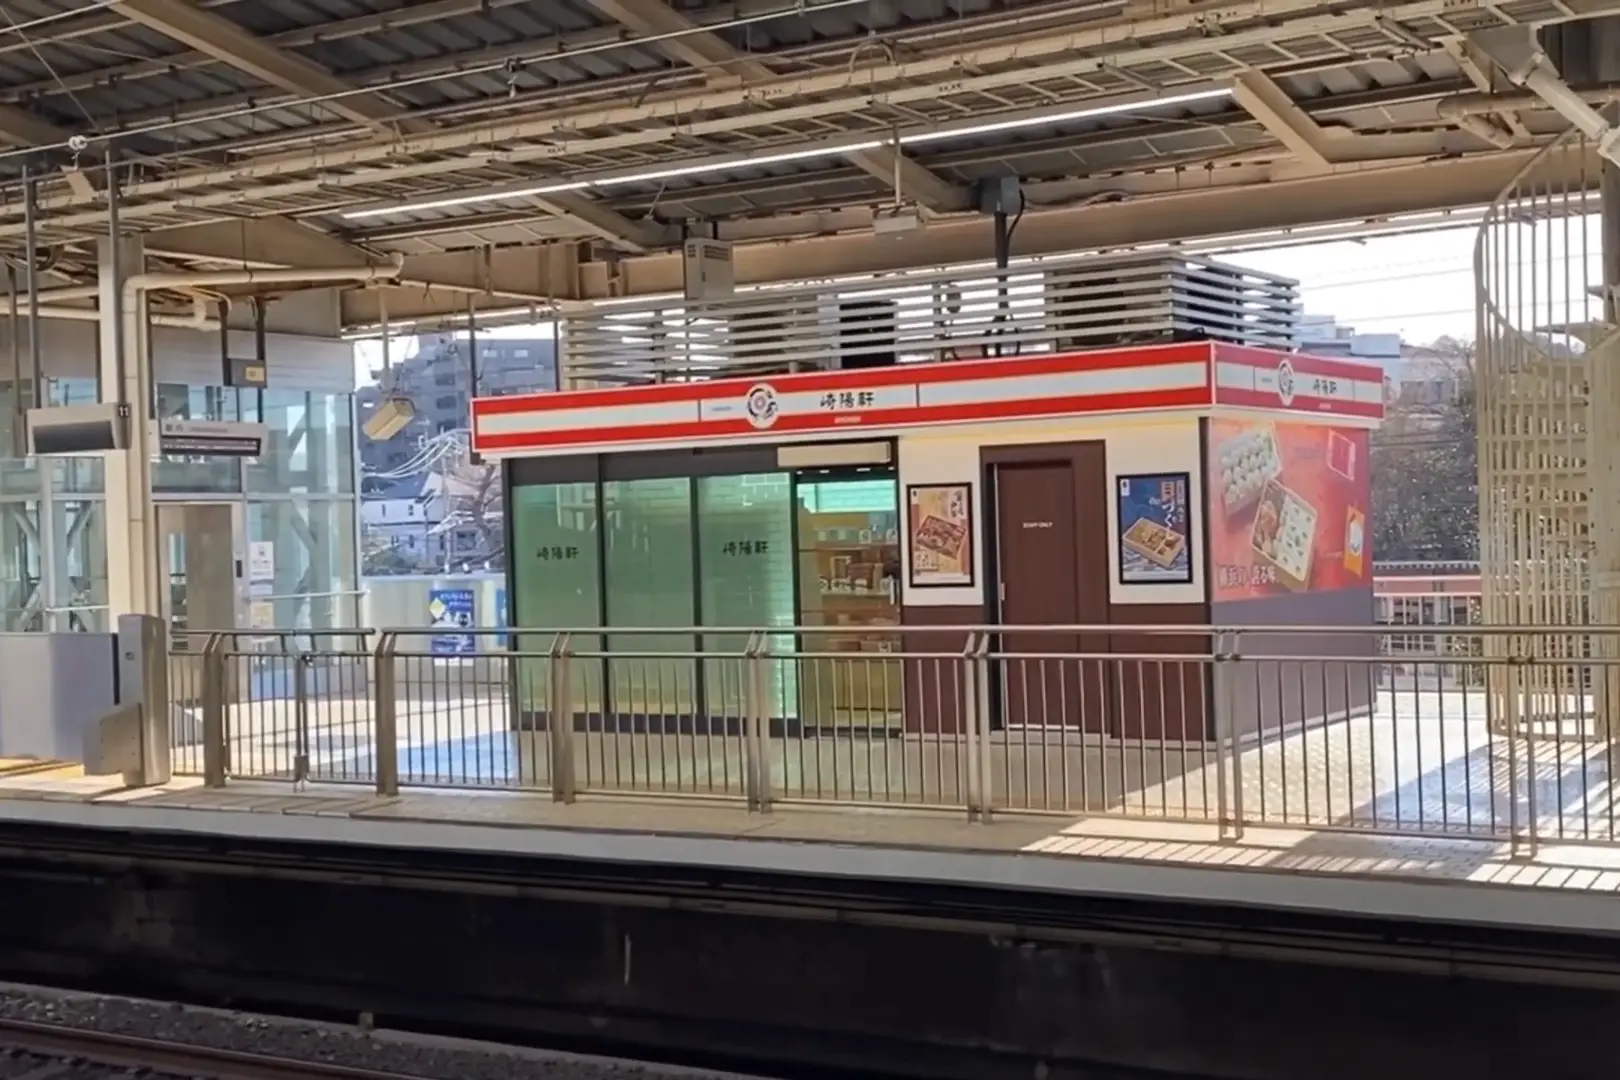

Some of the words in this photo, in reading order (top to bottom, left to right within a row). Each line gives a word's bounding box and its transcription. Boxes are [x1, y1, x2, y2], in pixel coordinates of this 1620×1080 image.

[820, 391, 875, 410] 崎陽軒
[536, 546, 579, 561] 崎陽軒
[722, 540, 769, 557] 崎陽軒
